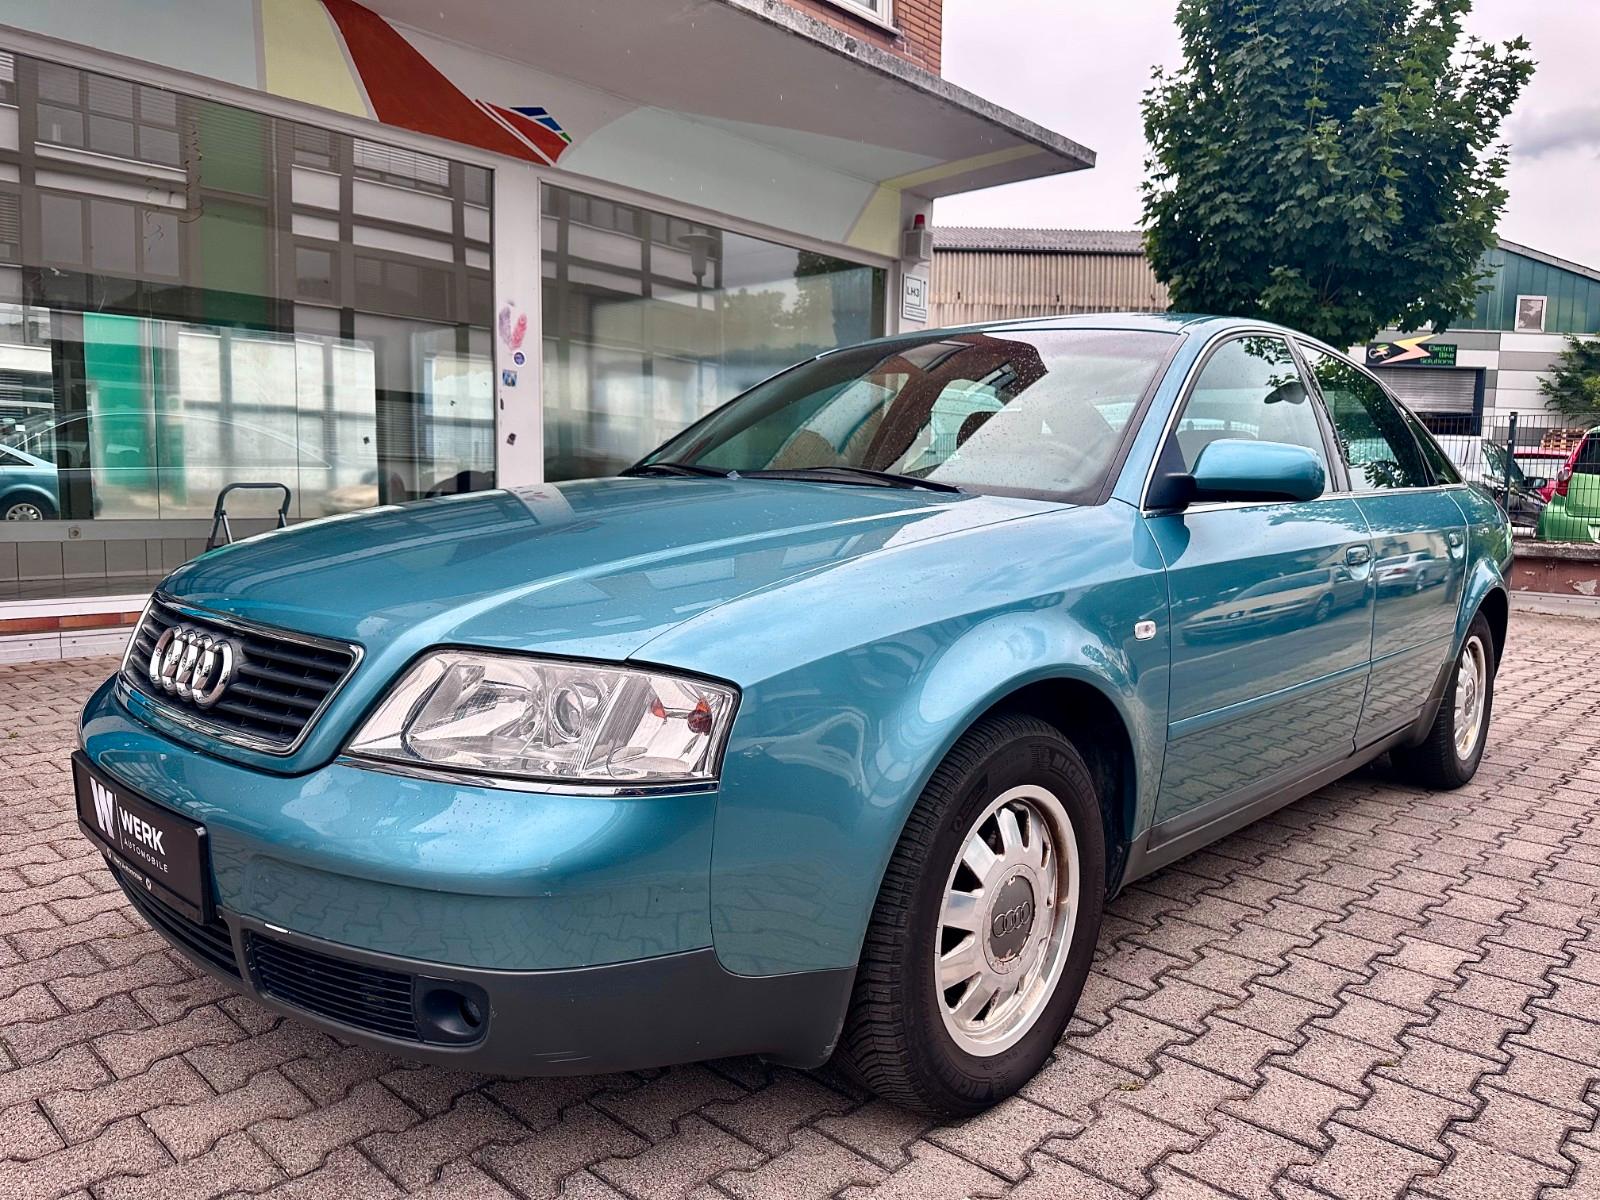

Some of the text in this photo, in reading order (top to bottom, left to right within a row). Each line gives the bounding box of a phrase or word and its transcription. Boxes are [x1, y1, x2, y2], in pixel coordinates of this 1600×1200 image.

[906, 286, 920, 297] LH3
[119, 806, 166, 856] WERK
[124, 839, 169, 874] AUTOMOBILE
